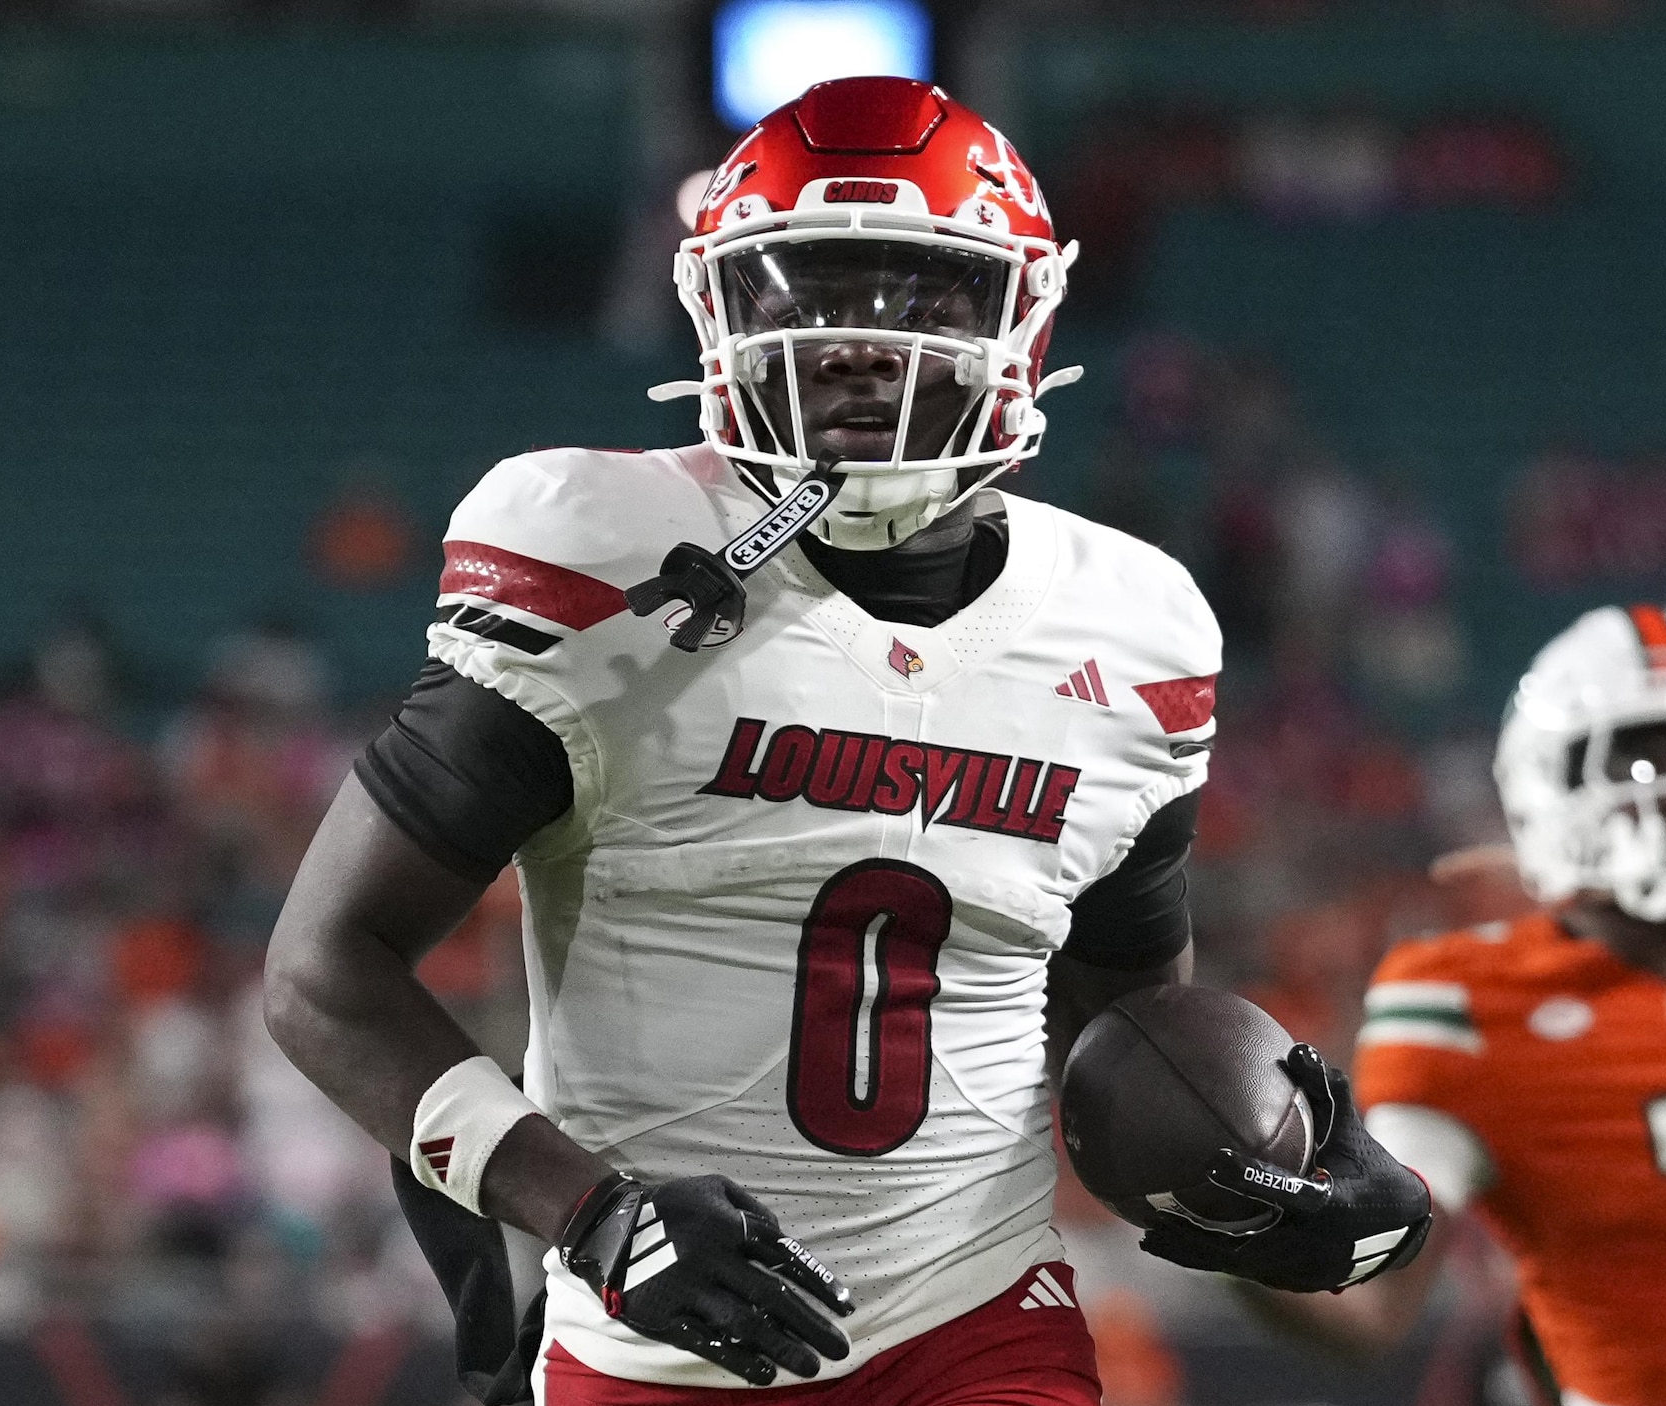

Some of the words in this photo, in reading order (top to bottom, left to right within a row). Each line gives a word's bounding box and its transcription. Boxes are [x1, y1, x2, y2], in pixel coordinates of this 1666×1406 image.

[823, 181, 899, 204] CARDS
[733, 487, 822, 563] BATTLE
[695, 716, 1082, 845] LOUISVILLE
[786, 857, 954, 1158] 0
[1243, 1166, 1304, 1194] ADIZERO
[776, 1237, 834, 1284] ADIZERO
